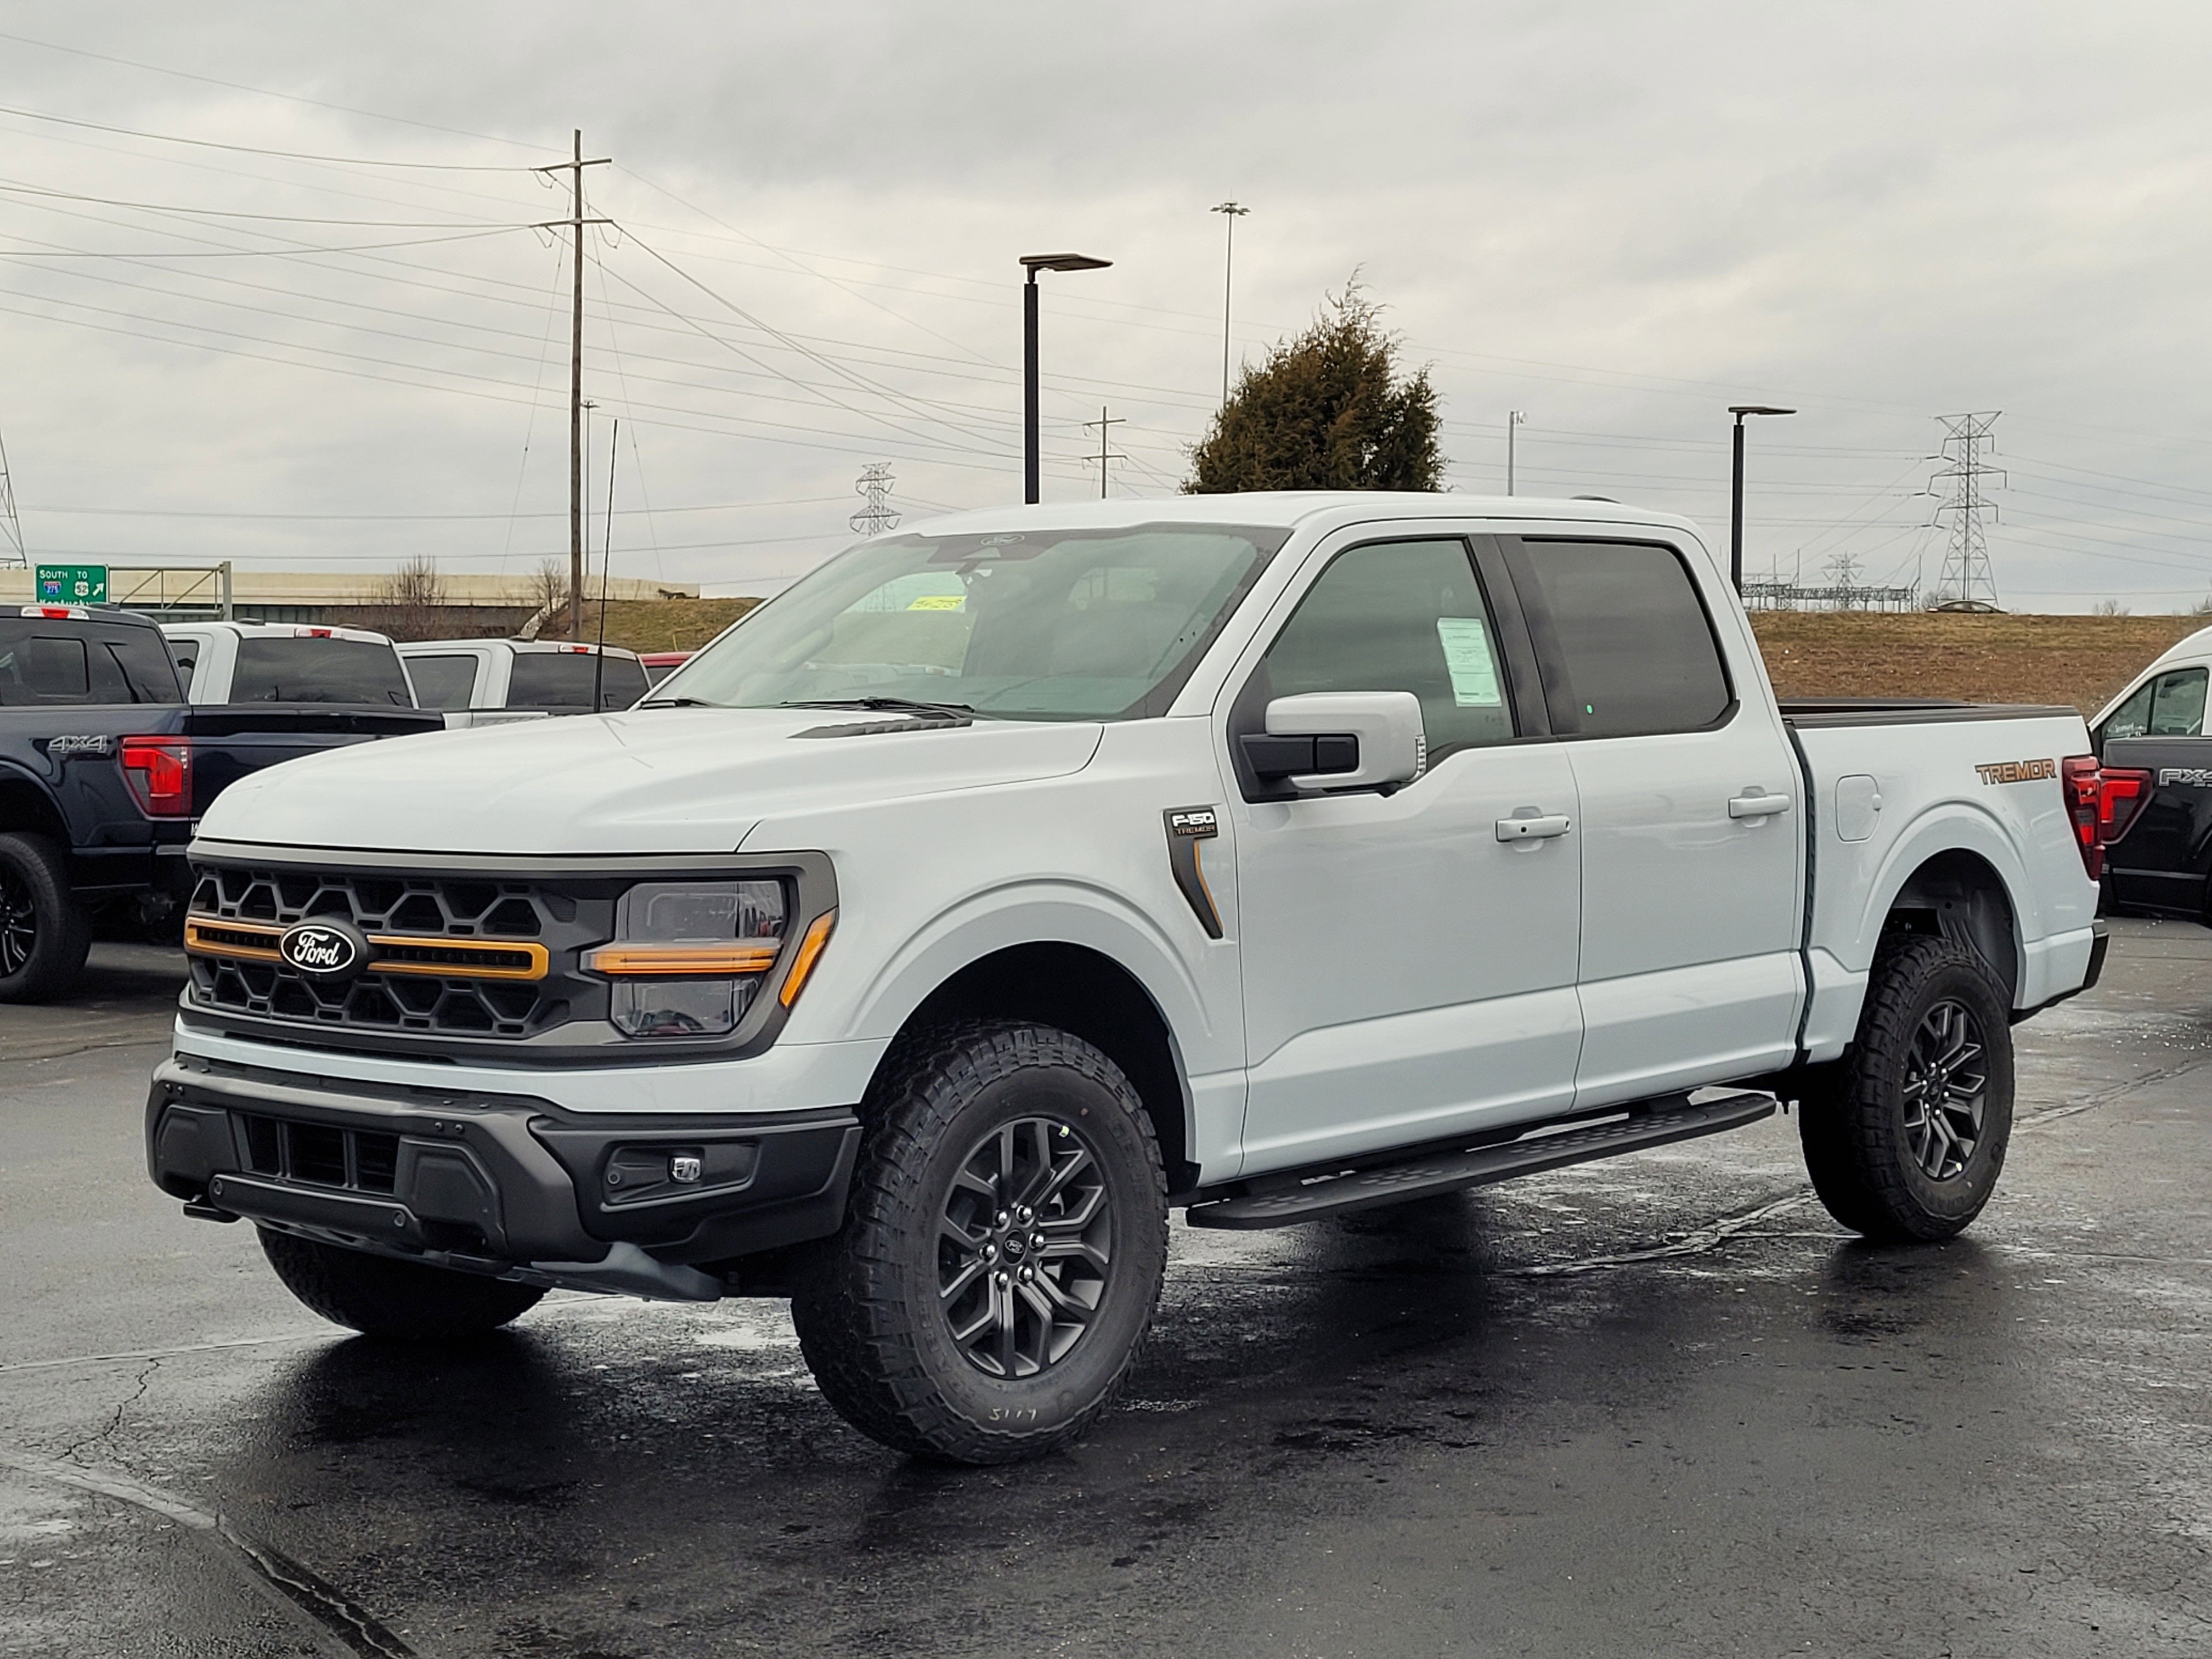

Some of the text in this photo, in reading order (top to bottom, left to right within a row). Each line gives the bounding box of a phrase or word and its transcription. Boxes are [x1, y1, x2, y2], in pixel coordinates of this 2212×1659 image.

[39, 569, 88, 579] SOUTH TO
[76, 584, 88, 594] 52
[1974, 758, 2057, 785] TREMOR
[1171, 812, 1215, 827] F-150
[294, 931, 341, 966] Ford
